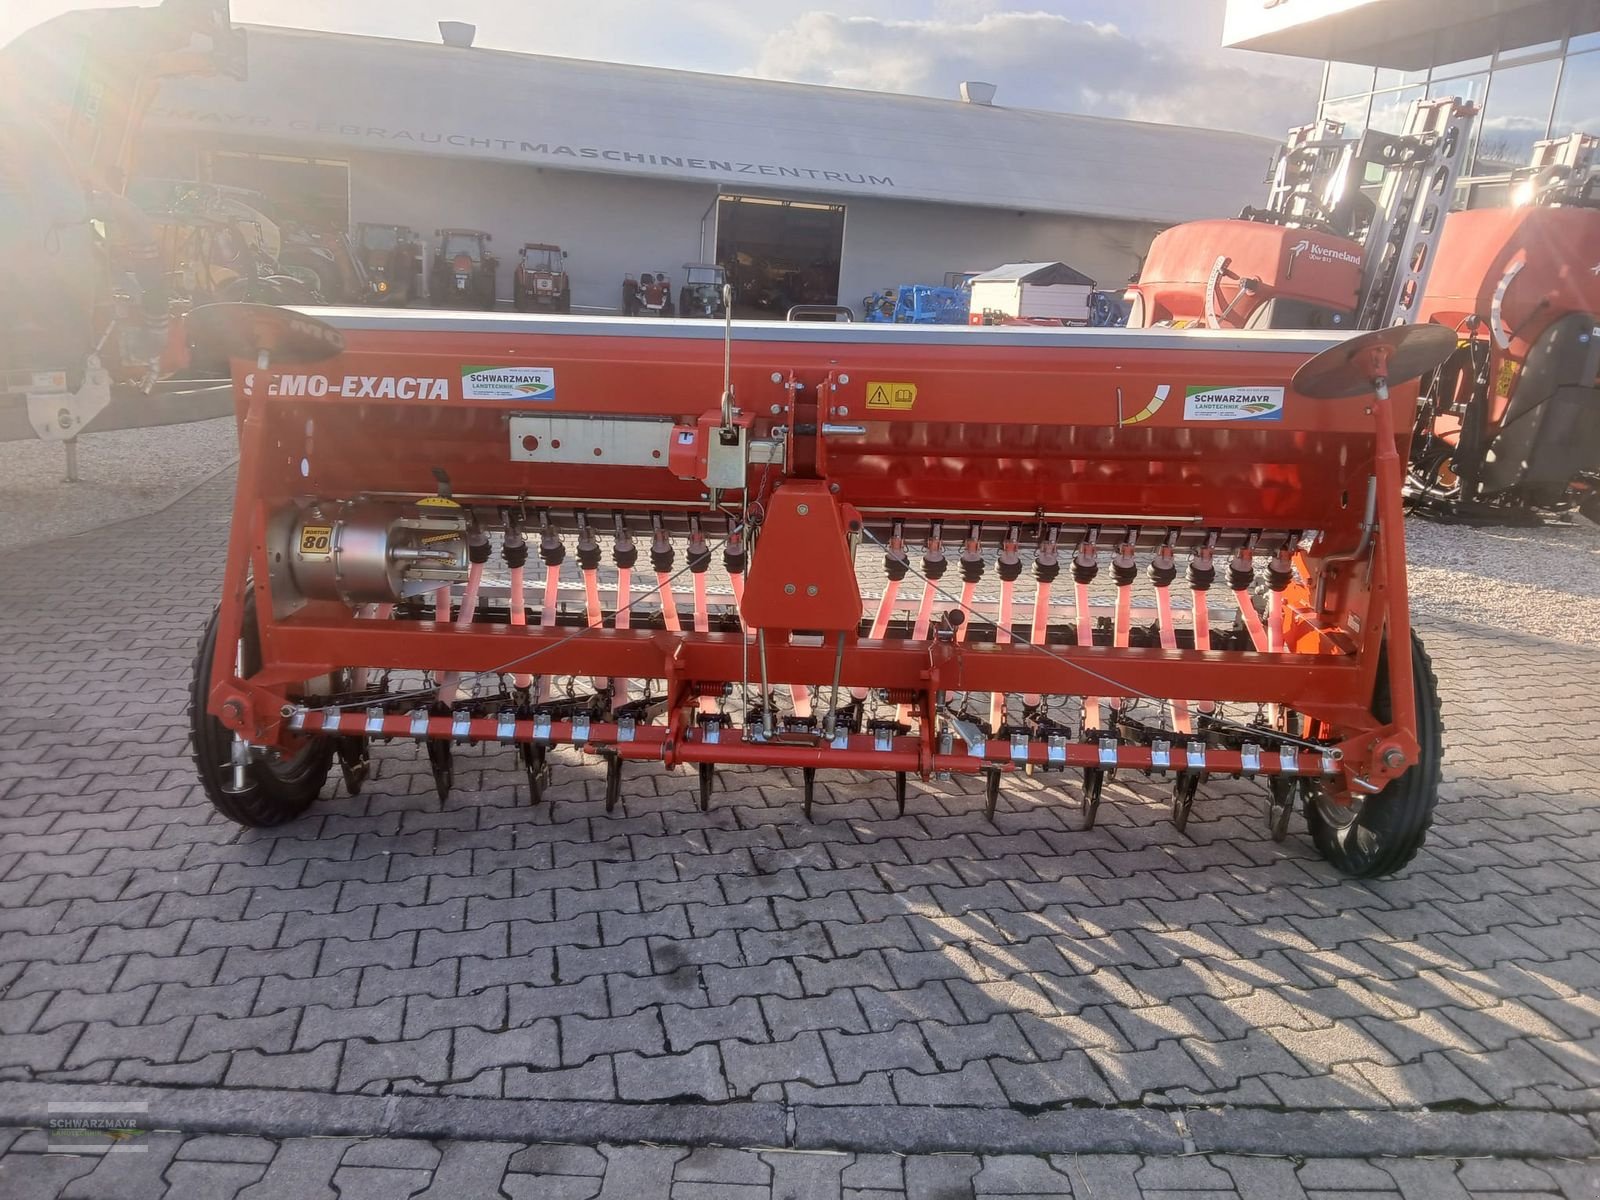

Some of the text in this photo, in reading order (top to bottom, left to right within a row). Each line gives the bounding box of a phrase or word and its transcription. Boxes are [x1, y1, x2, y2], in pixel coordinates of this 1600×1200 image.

[288, 120, 894, 186] GEBRAUCHTMASCHINENZENTRUM
[1311, 244, 1360, 265] Kverneland
[471, 374, 541, 383] SCHWARZMAYR
[1194, 395, 1270, 403] SCHWARZMAYR
[303, 536, 328, 549] 80
